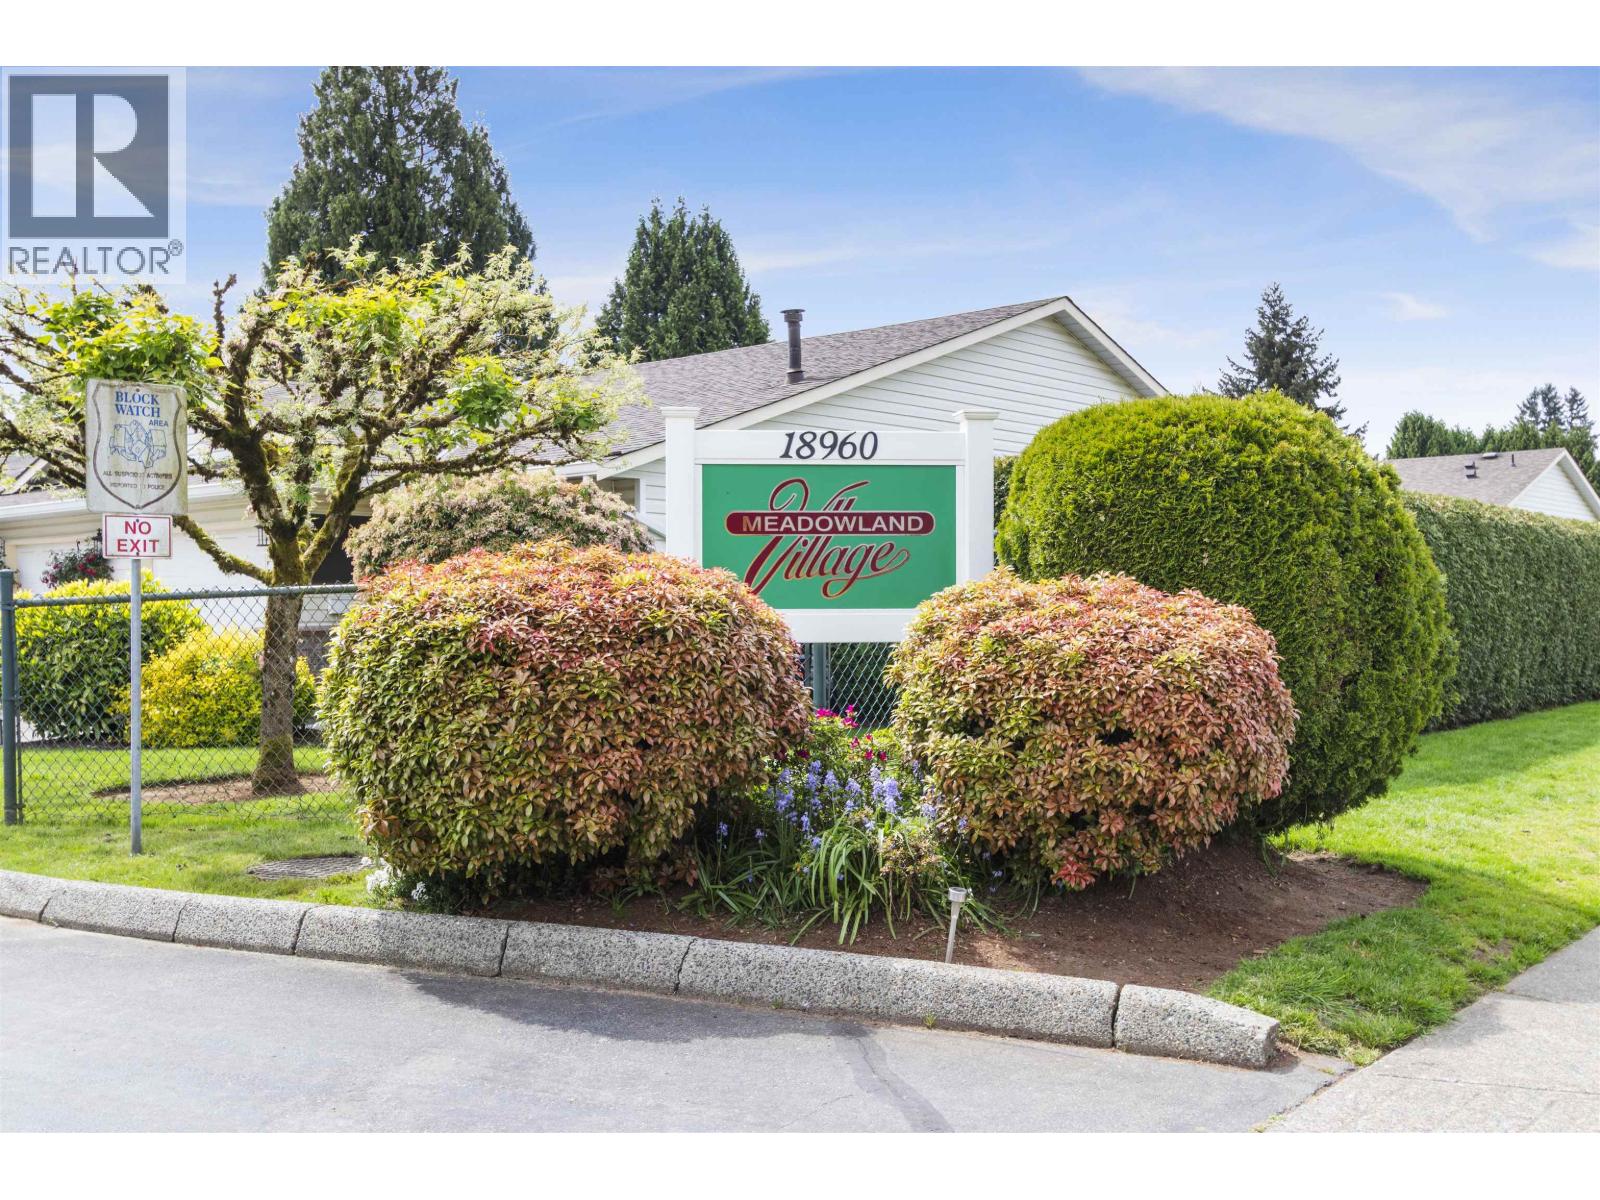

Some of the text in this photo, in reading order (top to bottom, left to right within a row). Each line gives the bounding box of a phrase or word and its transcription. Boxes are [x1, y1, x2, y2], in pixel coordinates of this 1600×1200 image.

[115, 391, 160, 405] BLOCK
[115, 404, 160, 417] WATCH
[779, 431, 878, 460] 18960
[124, 521, 152, 535] NO
[742, 515, 924, 532] MEADOWLAND
[117, 539, 159, 553] EXIT
[743, 478, 911, 600] Village
